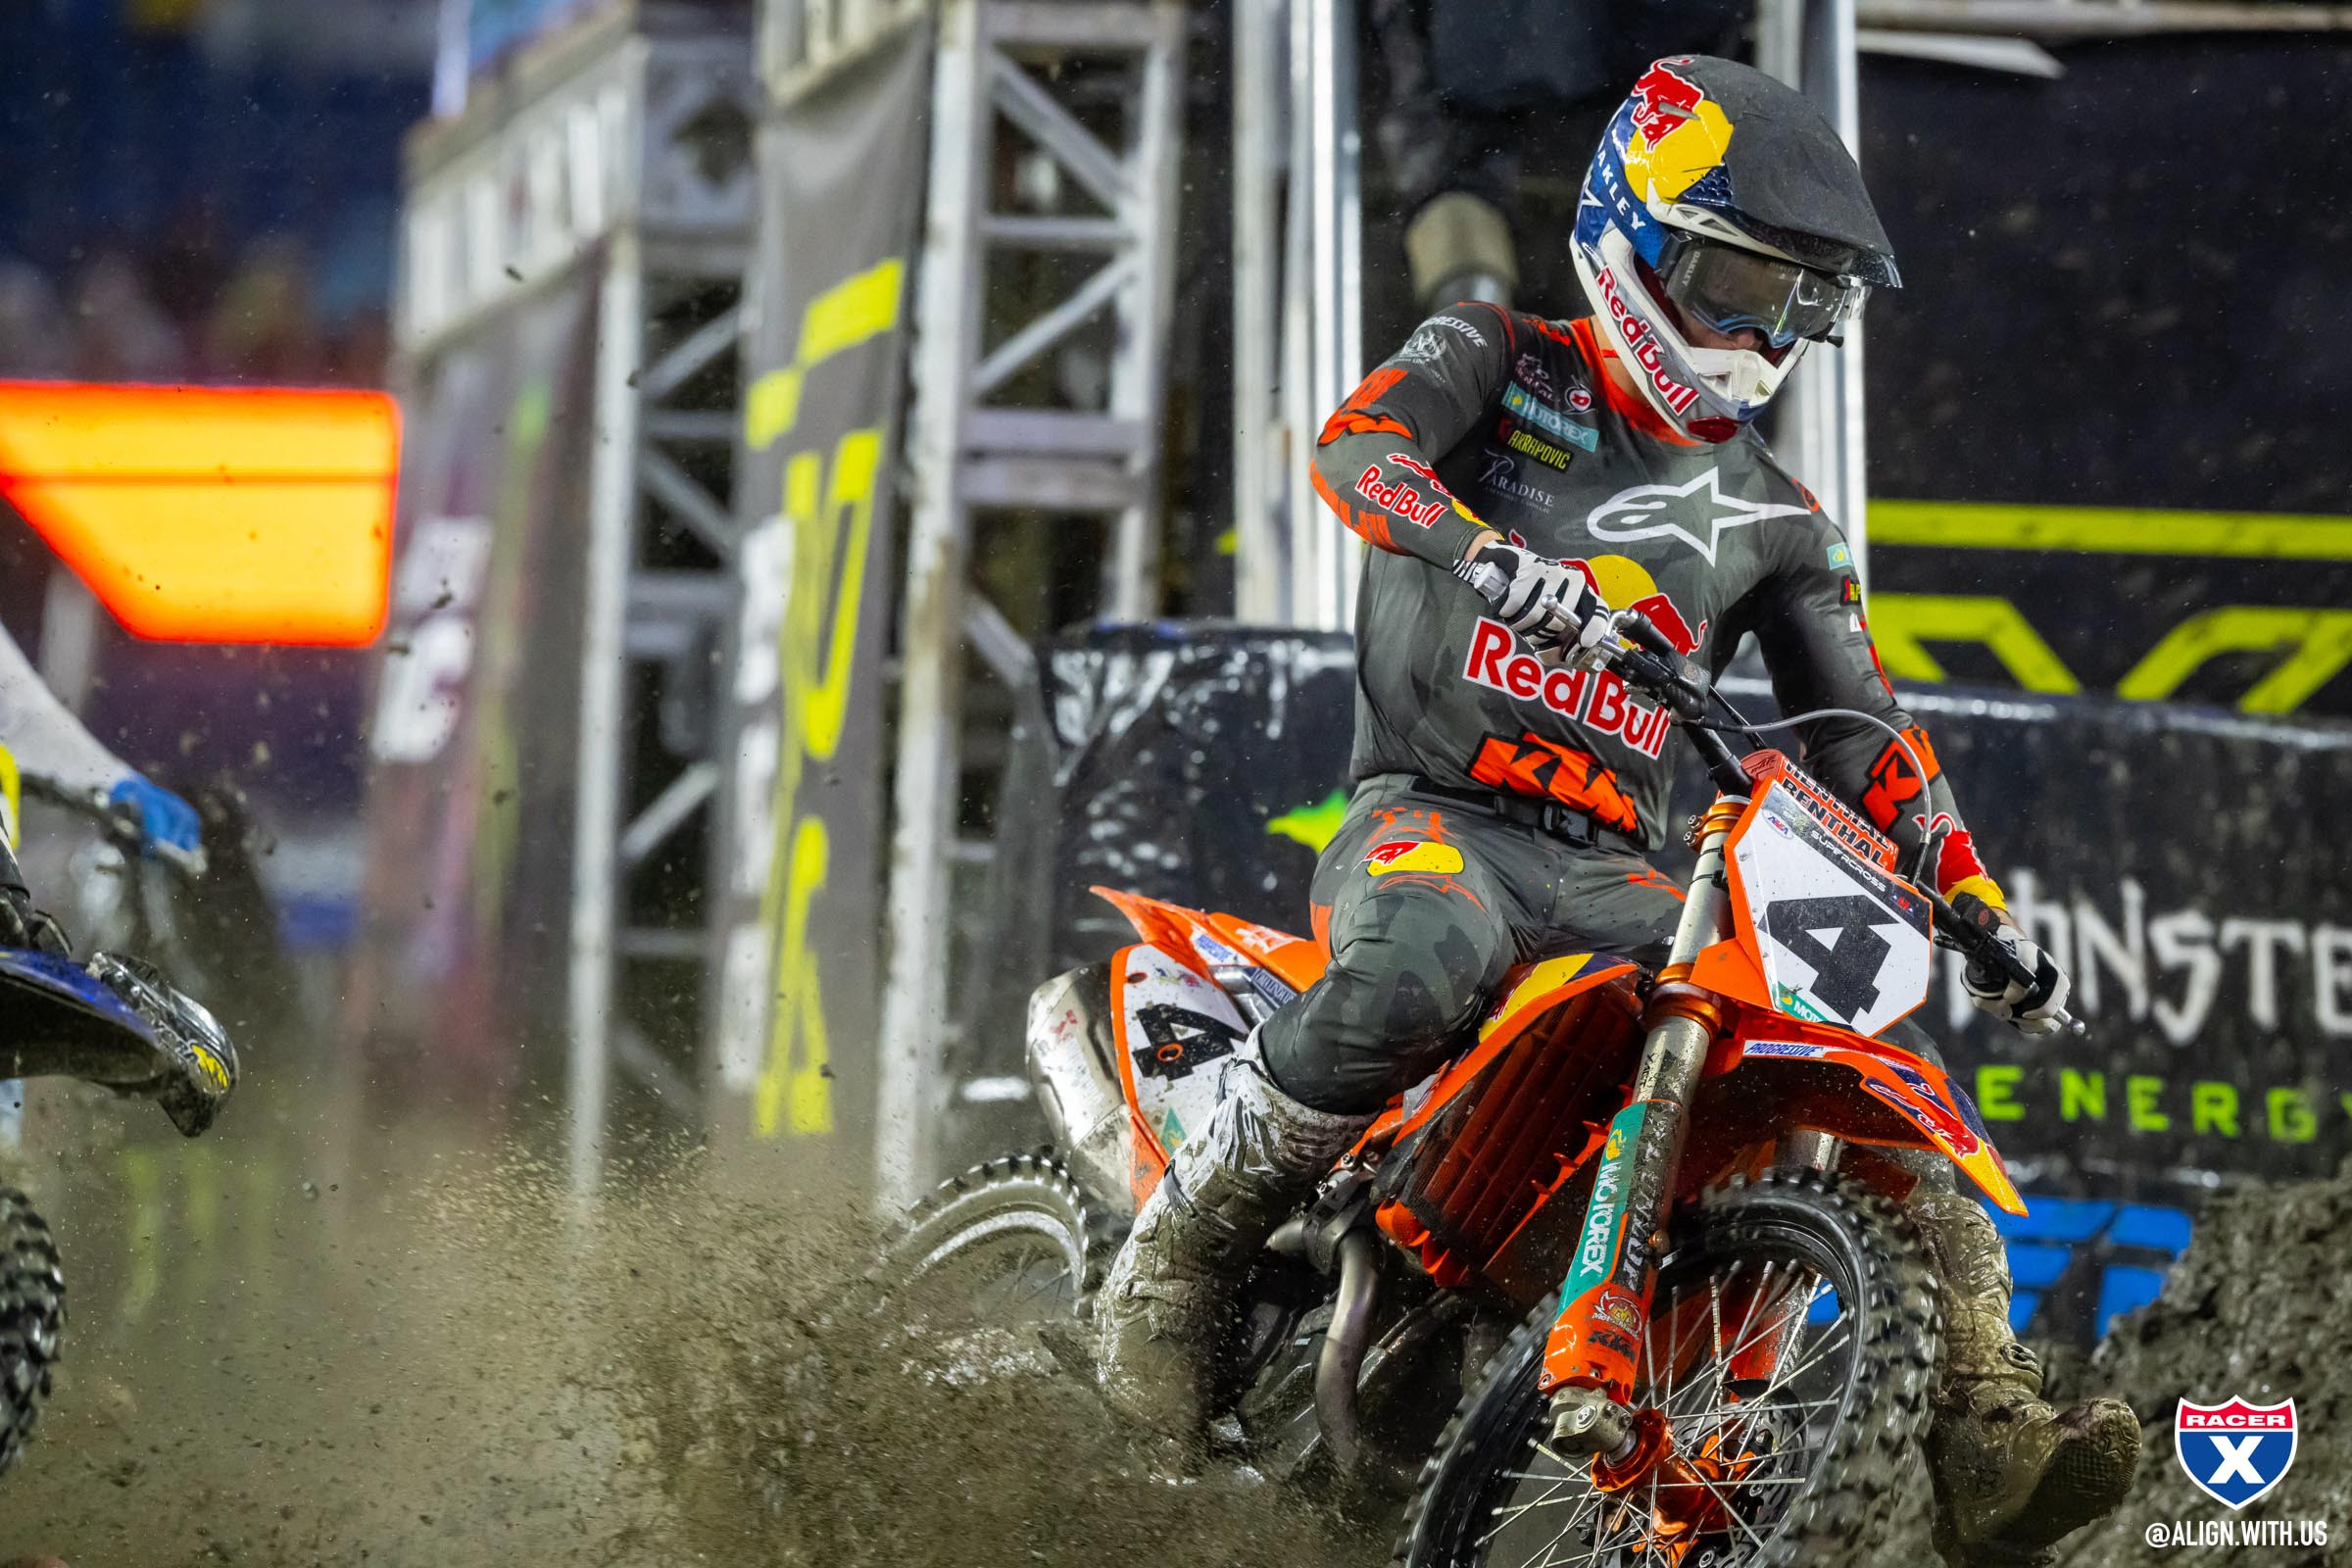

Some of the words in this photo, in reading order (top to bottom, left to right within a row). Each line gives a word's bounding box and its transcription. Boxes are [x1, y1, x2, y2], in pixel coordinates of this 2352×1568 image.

[1597, 134, 1646, 230] AKLEY
[1596, 265, 1651, 347] Red
[1635, 340, 1699, 416] Bull
[1354, 463, 1407, 509] Red
[1391, 487, 1448, 529] Bull
[1462, 614, 1588, 720] Red
[1583, 668, 1670, 760] Bull
[1782, 777, 1887, 869] RENTHAL
[1757, 894, 1900, 1025] 4
[1132, 1004, 1249, 1081] 4
[1744, 1042, 1822, 1057] PROGRESSIVE
